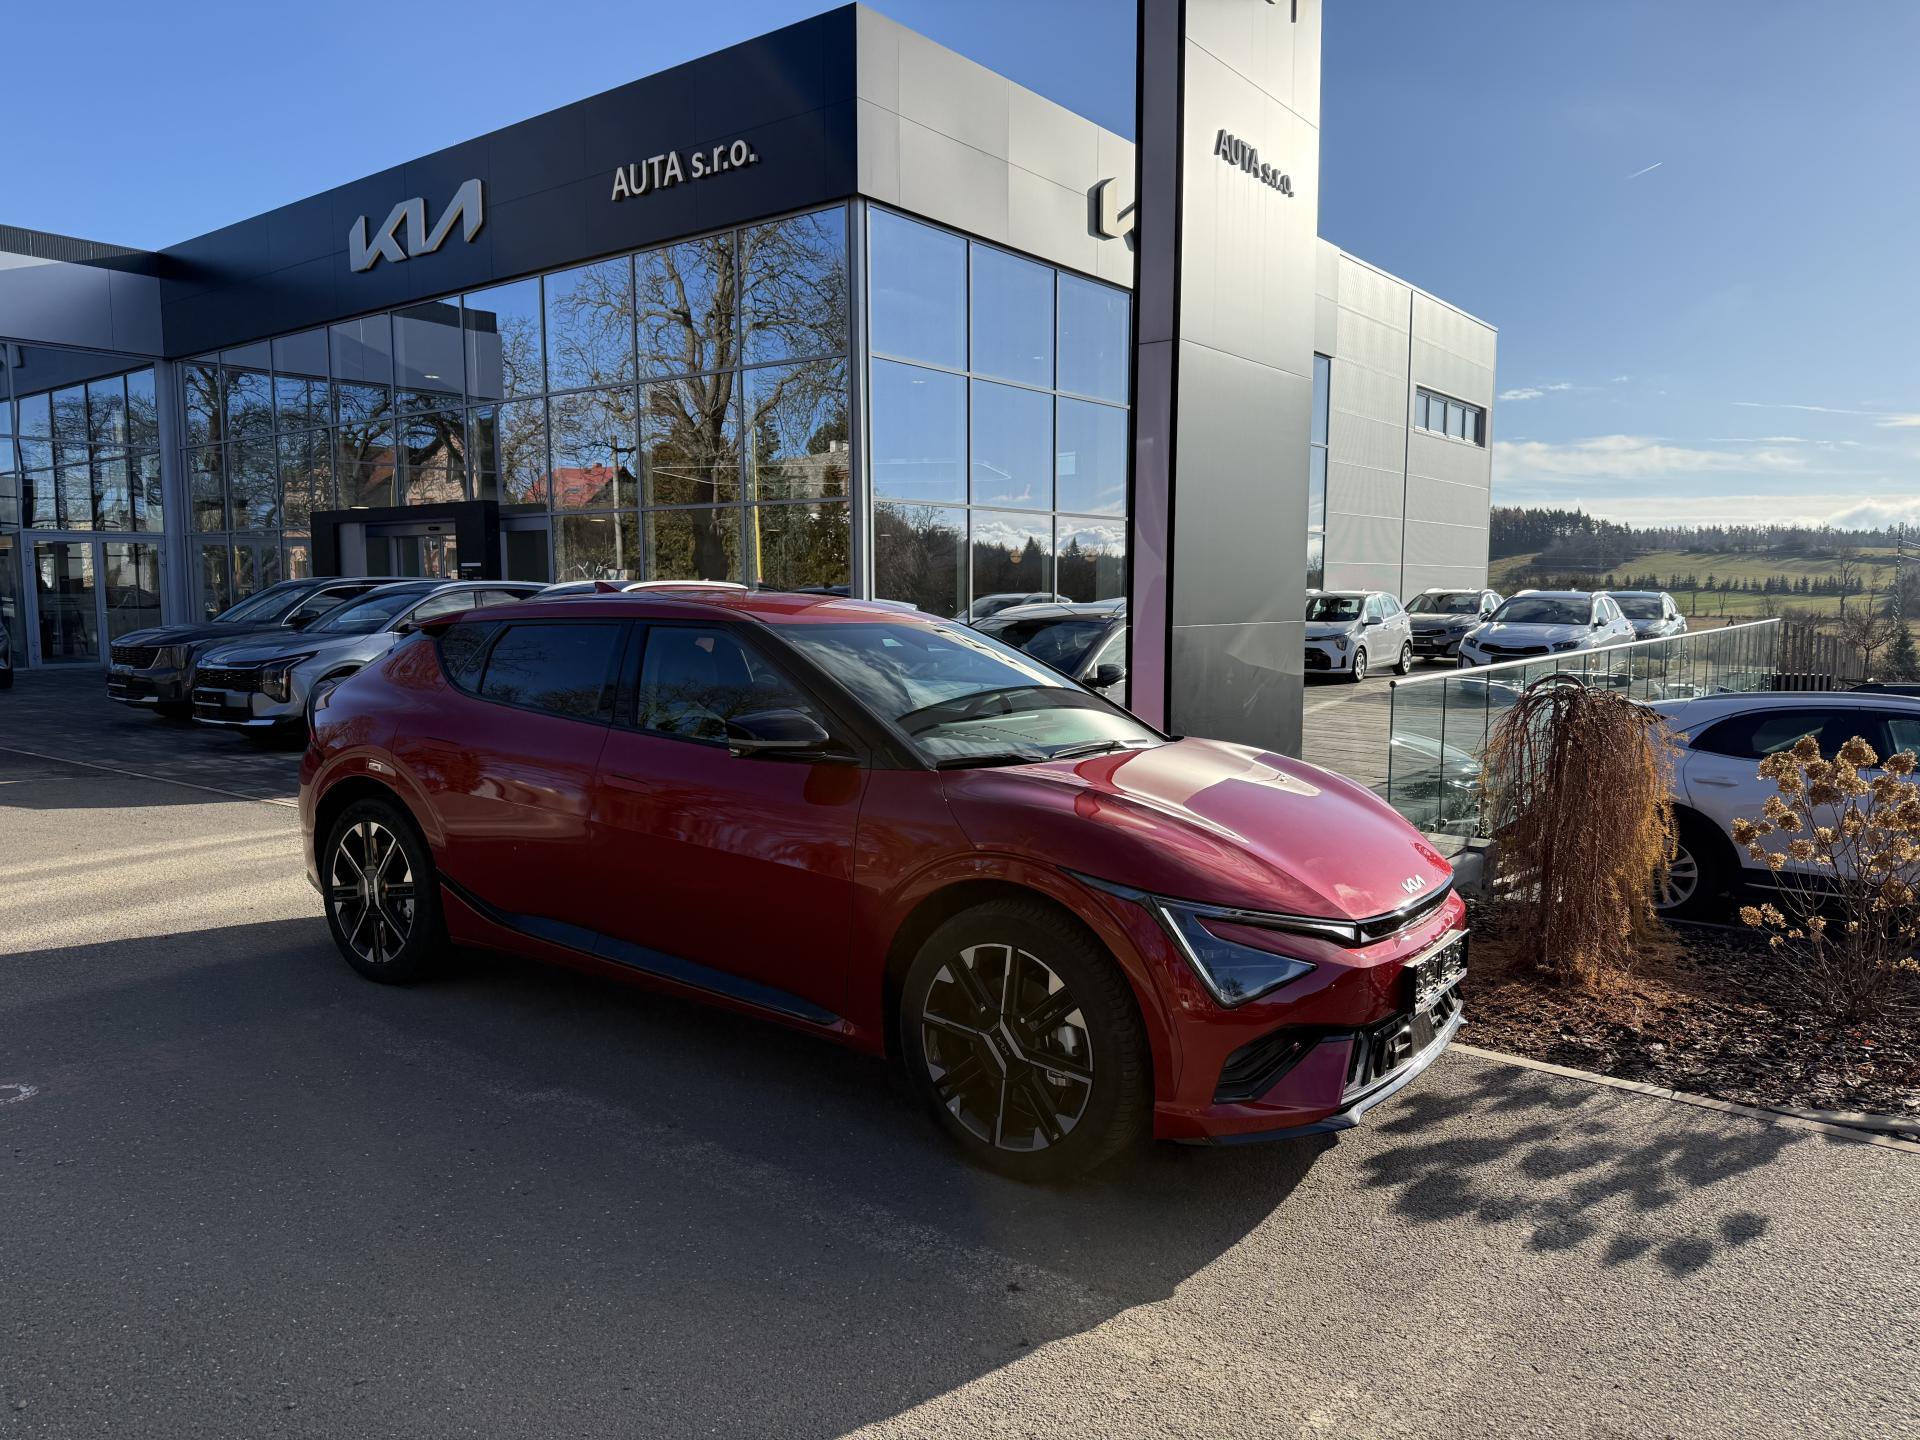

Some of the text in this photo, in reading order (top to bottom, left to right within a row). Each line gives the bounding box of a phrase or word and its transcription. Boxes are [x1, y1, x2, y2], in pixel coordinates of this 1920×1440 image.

[611, 139, 757, 201] AUTA s.r.o.
[1213, 128, 1295, 198] AUTA s.r.o.
[349, 178, 483, 273] KIA
[1401, 874, 1426, 894] KIA
